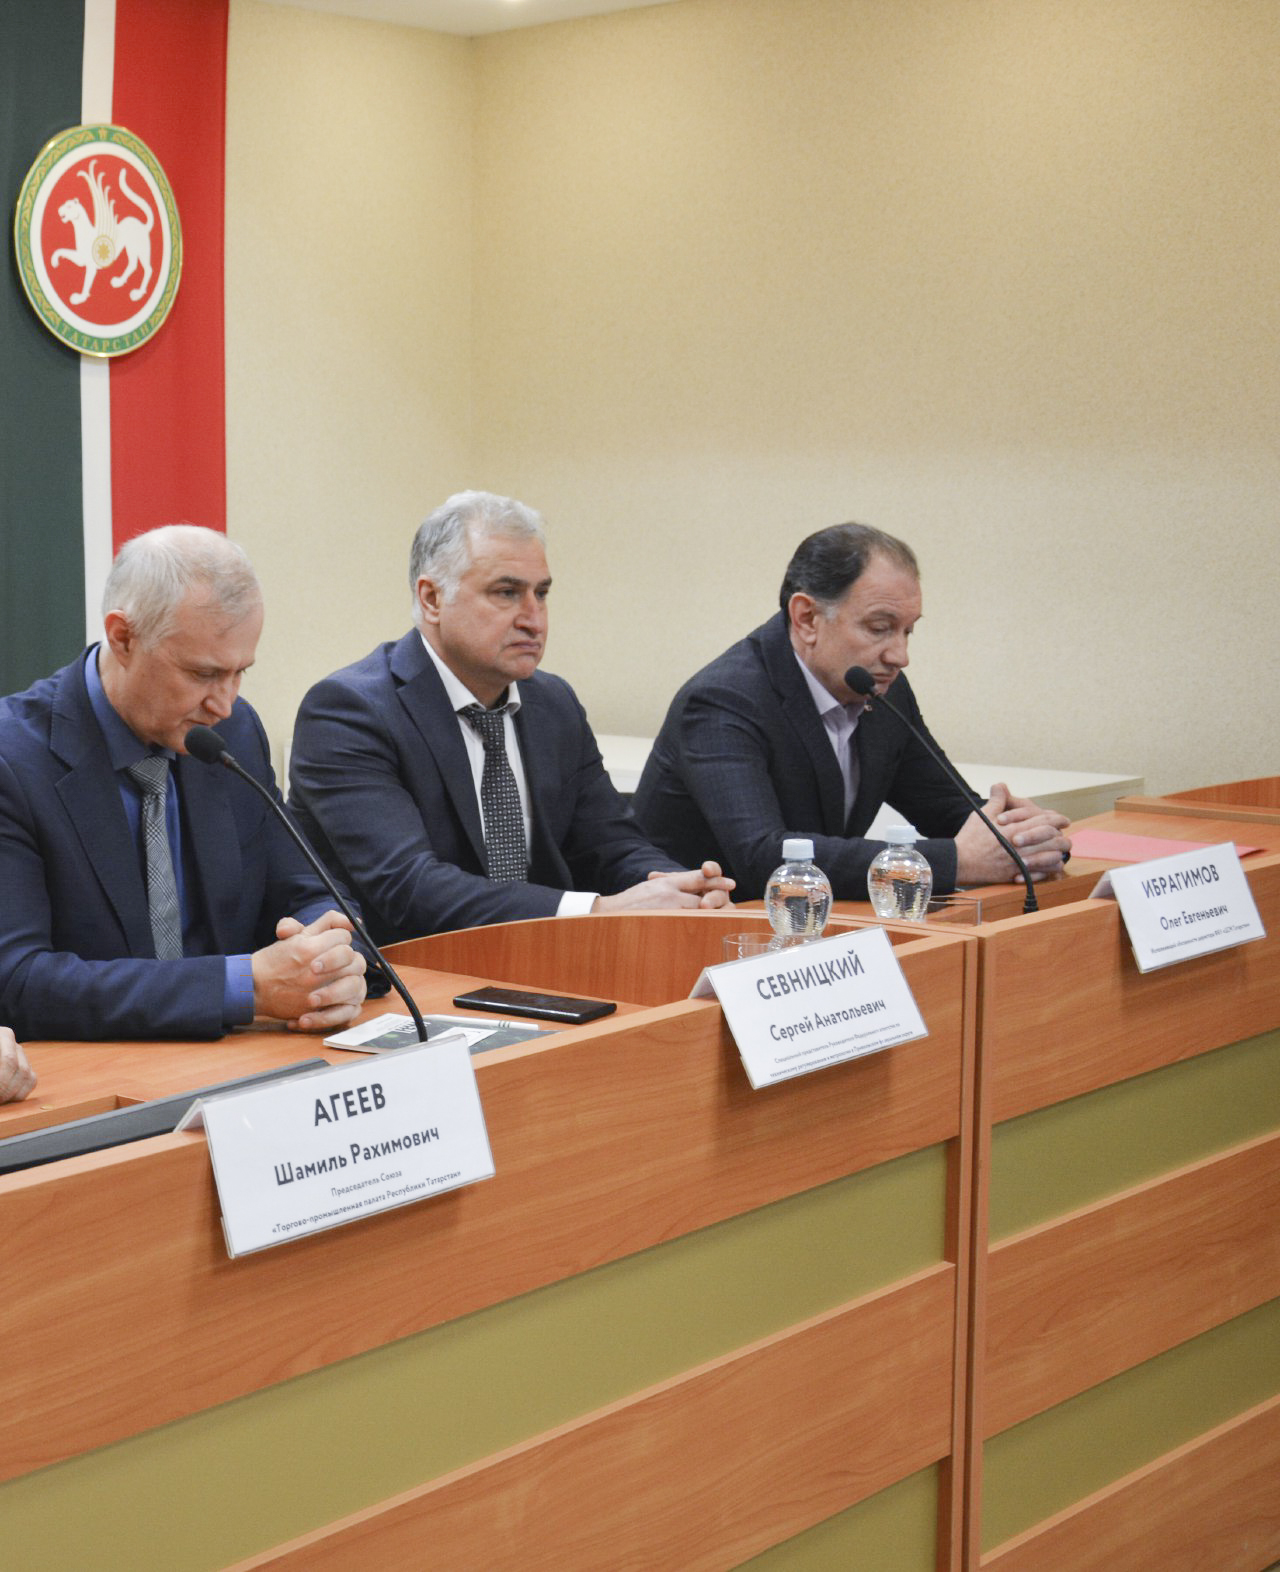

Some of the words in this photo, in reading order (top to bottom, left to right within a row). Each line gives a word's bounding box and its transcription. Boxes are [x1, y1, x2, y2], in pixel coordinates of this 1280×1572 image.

[61, 323, 149, 352] ТАТАРСТАН
[1141, 864, 1220, 898] ИБРАГИМОВ
[1160, 915, 1182, 931] Олег
[1181, 905, 1228, 924] Евгеньевич
[757, 950, 865, 1000] СЕВНИЦКИЙ
[770, 1016, 814, 1042] Сергей
[816, 999, 887, 1028] Анатольевич
[314, 1083, 386, 1126] АГЕЕВ
[274, 1155, 348, 1186] Шамиль
[350, 1127, 440, 1164] Рахимович
[331, 1178, 380, 1197] Председатель
[381, 1170, 403, 1182] Союза
[364, 1194, 386, 1206] палата
[386, 1181, 426, 1199] Республики
